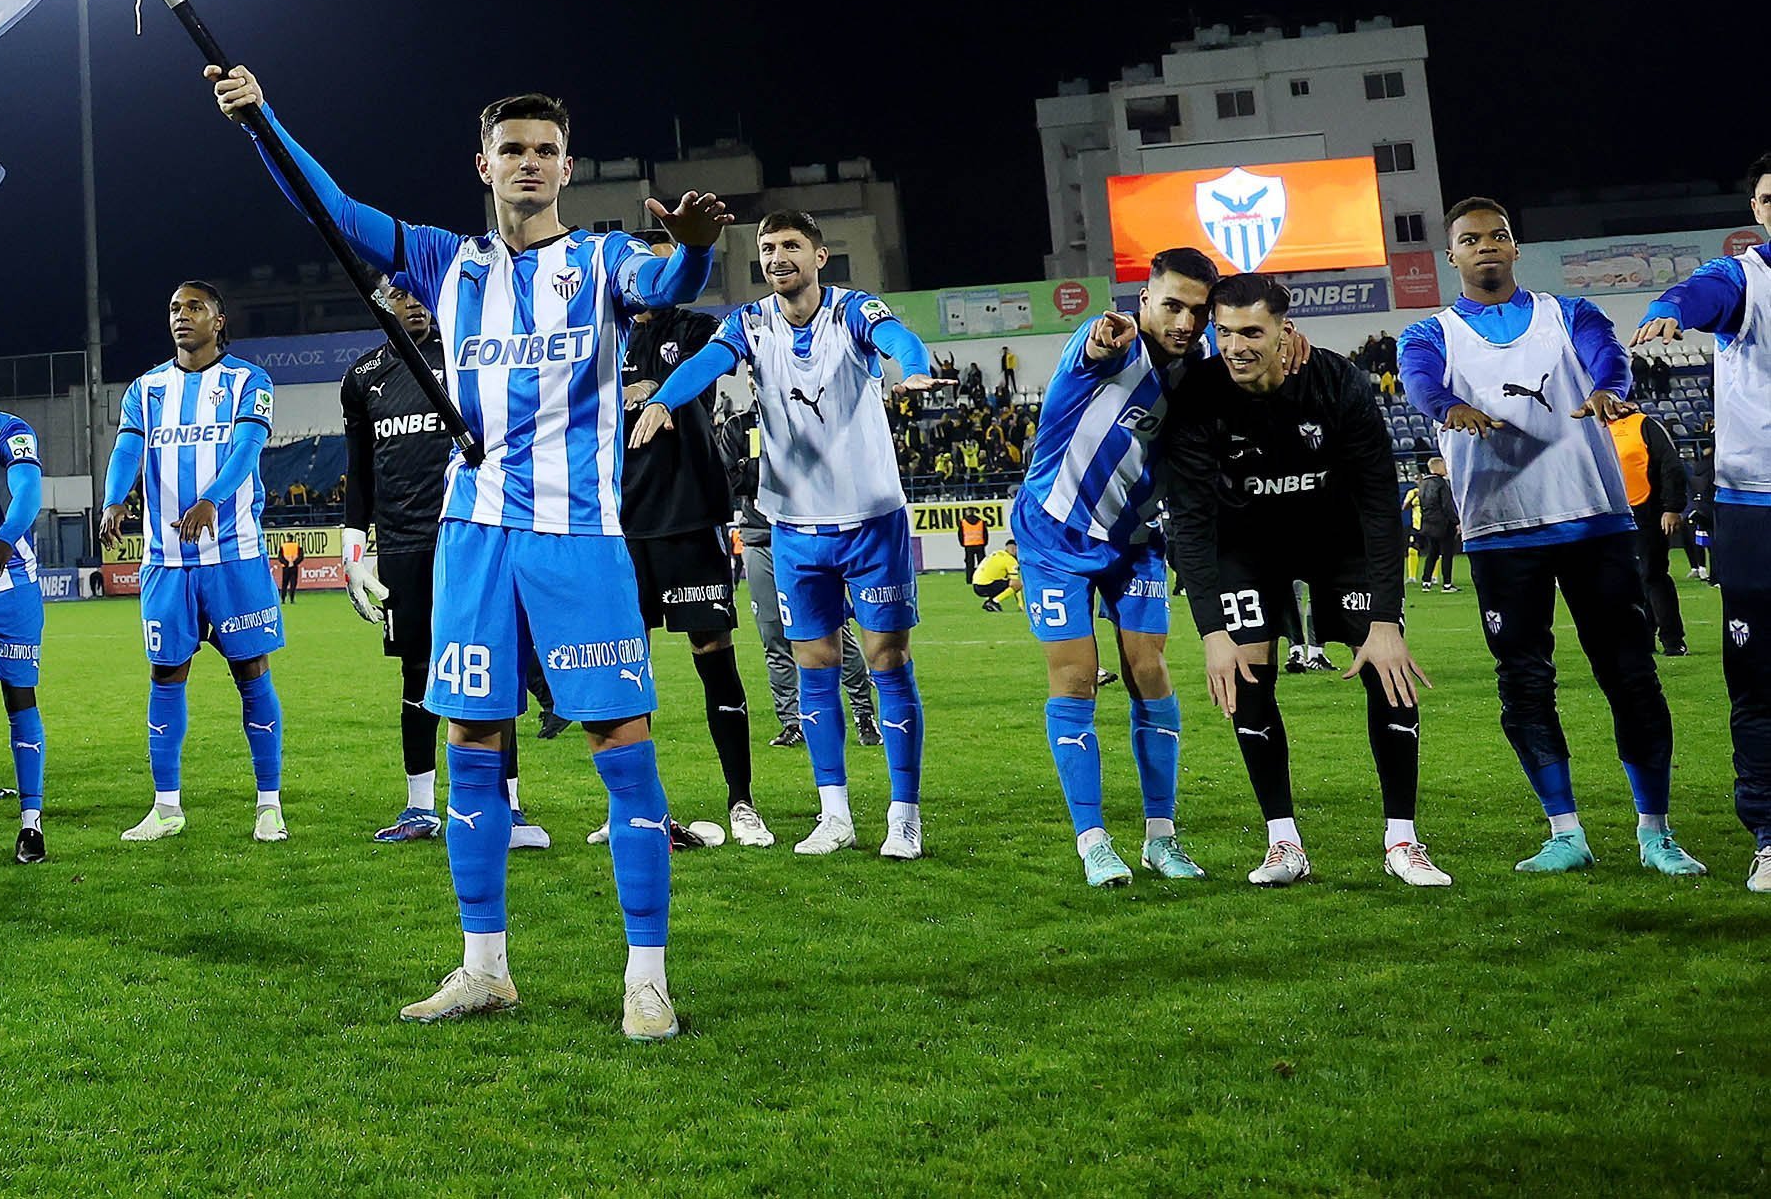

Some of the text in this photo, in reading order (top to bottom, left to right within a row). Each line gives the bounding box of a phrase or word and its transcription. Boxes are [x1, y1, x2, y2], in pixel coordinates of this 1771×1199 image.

[459, 331, 591, 367] FONBET
[151, 424, 230, 446] FONBET
[1042, 589, 1068, 627] 5
[1220, 589, 1265, 632] 93
[436, 642, 491, 698] 48
[579, 641, 618, 669] ZAVOS
